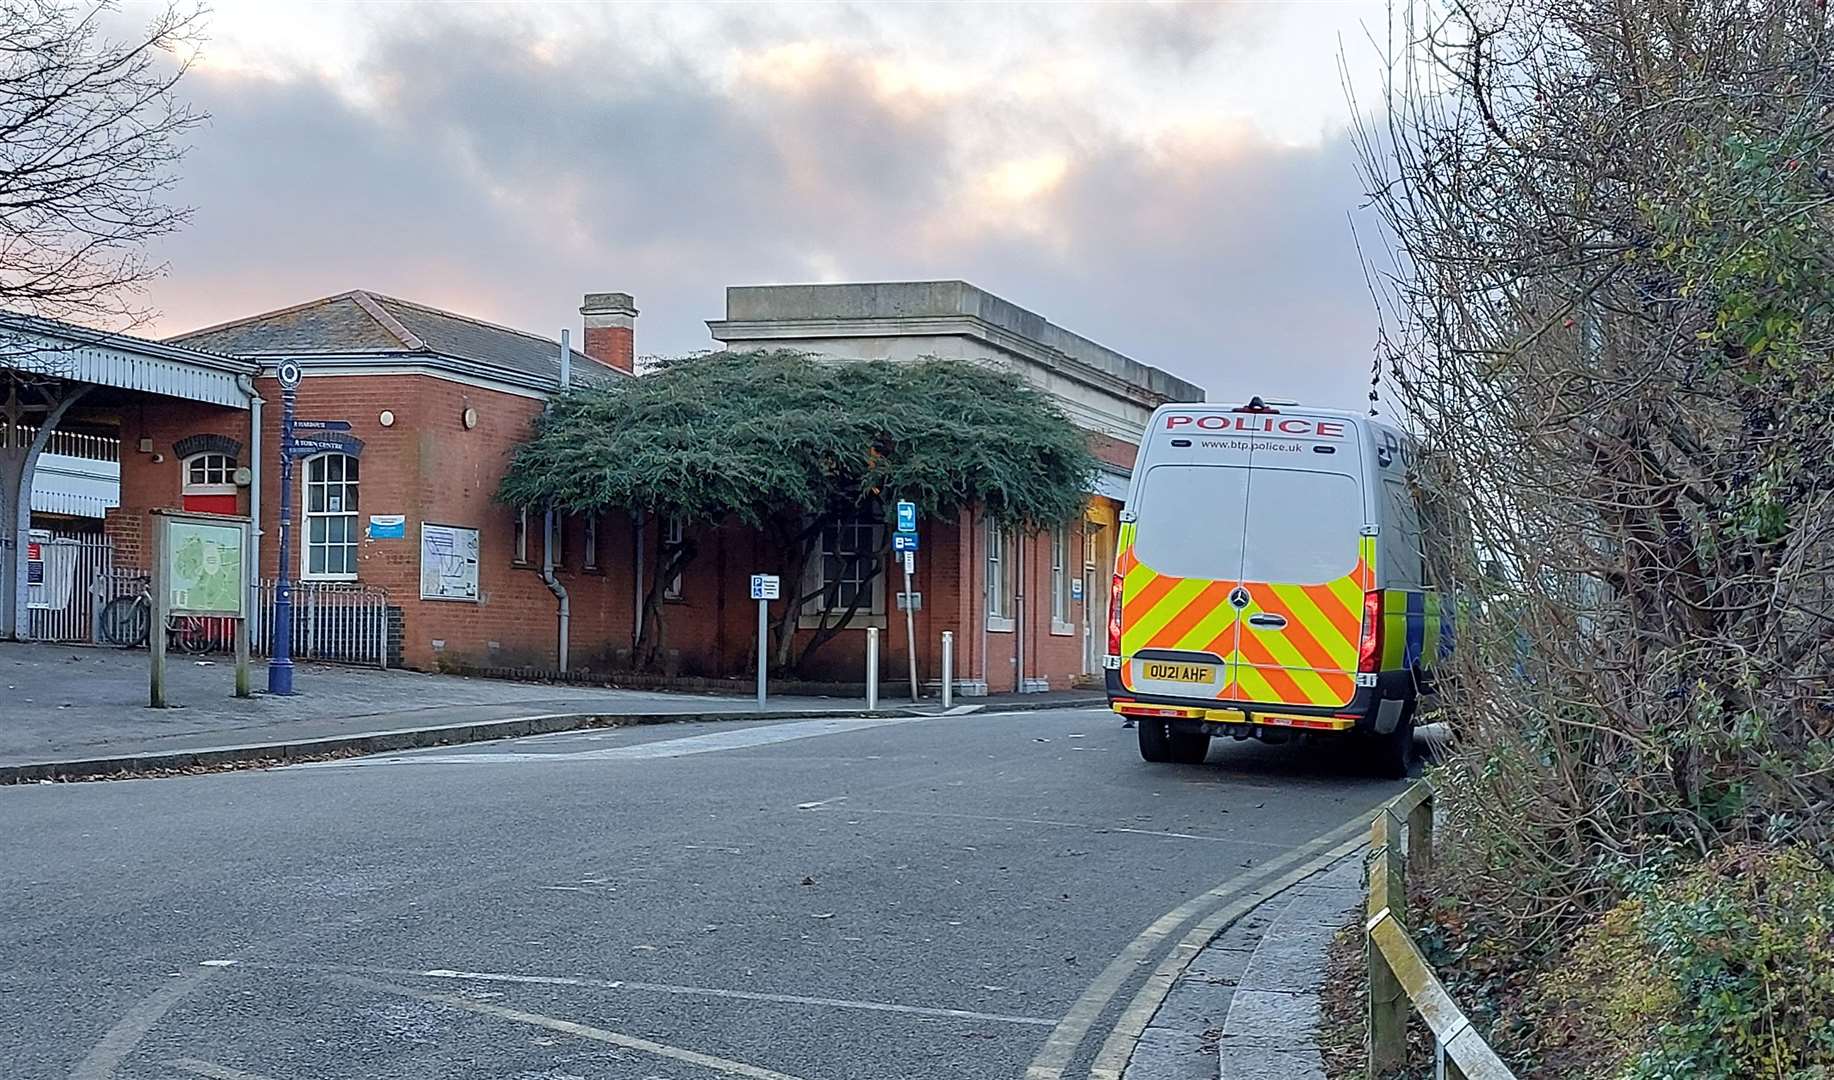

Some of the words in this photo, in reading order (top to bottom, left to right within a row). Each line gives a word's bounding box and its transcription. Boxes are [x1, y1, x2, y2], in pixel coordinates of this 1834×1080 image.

[1167, 416, 1345, 437] POLICE
[1201, 440, 1303, 453] www.btp.police.uk
[1150, 665, 1179, 679] OU21
[1182, 667, 1208, 681] AHF
